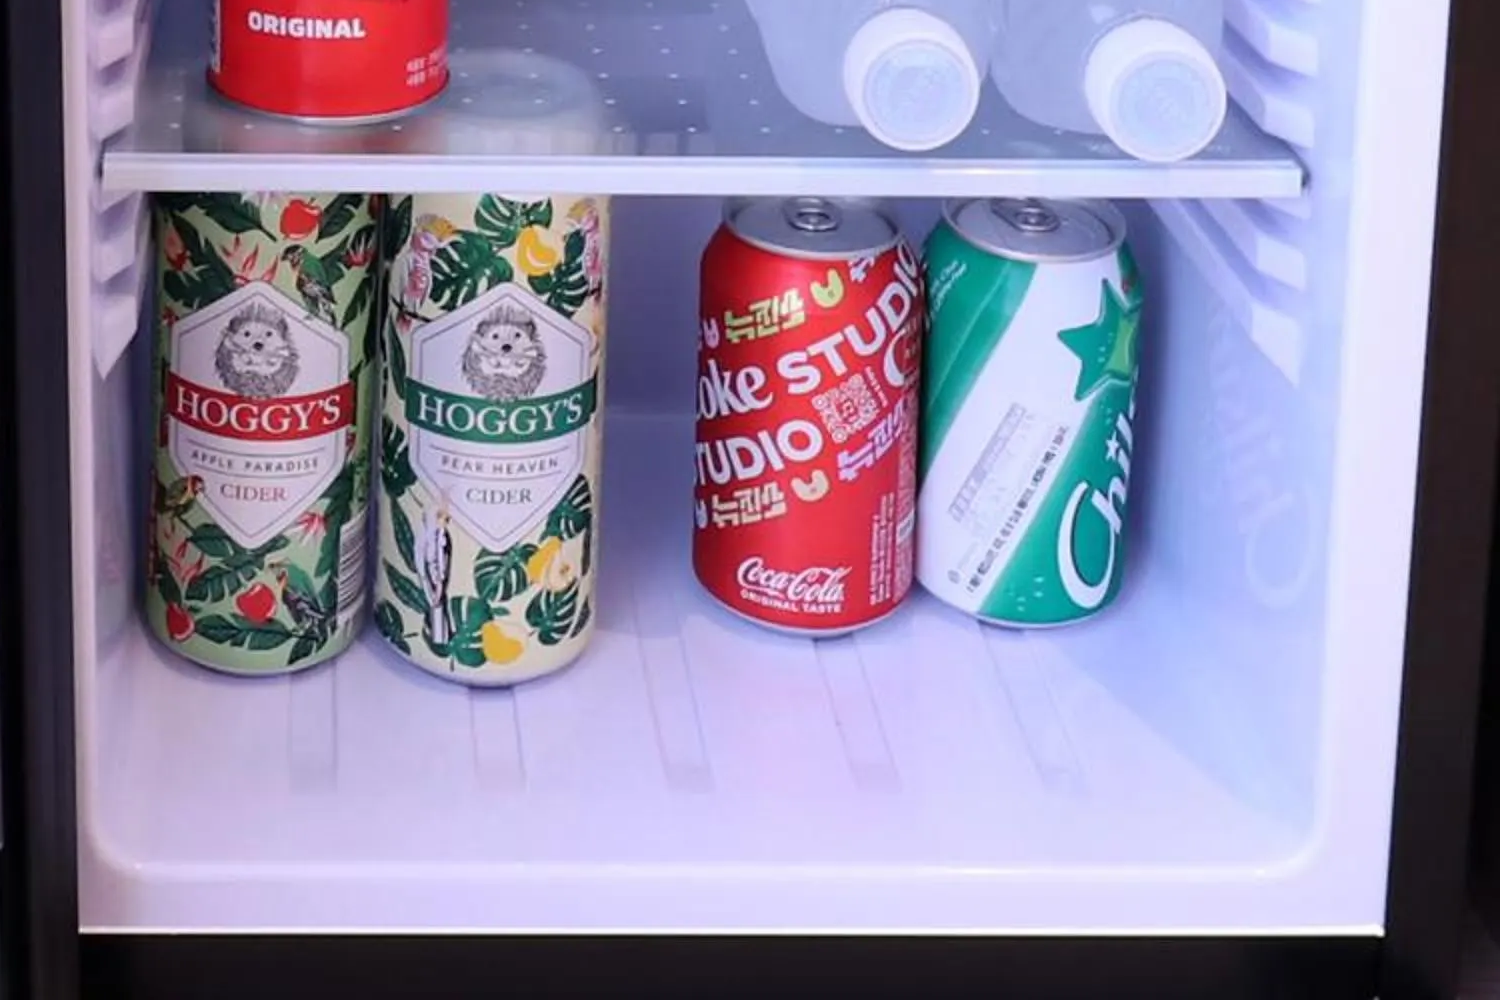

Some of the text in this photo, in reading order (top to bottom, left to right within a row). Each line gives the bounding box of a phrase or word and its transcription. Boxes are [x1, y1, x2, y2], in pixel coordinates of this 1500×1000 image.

[248, 11, 366, 39] ORIGINAL
[696, 359, 774, 420] oke
[176, 386, 342, 434] HOGGY'S
[418, 391, 584, 436] HOGGY'S
[191, 451, 319, 472] APPLE PARADISE
[441, 456, 559, 475] PEAR HEAVEN
[694, 419, 824, 486] TUDIO
[220, 483, 288, 502] CIDER
[466, 487, 533, 505] CIDER
[740, 589, 842, 614] ORIGINAL TASTE
